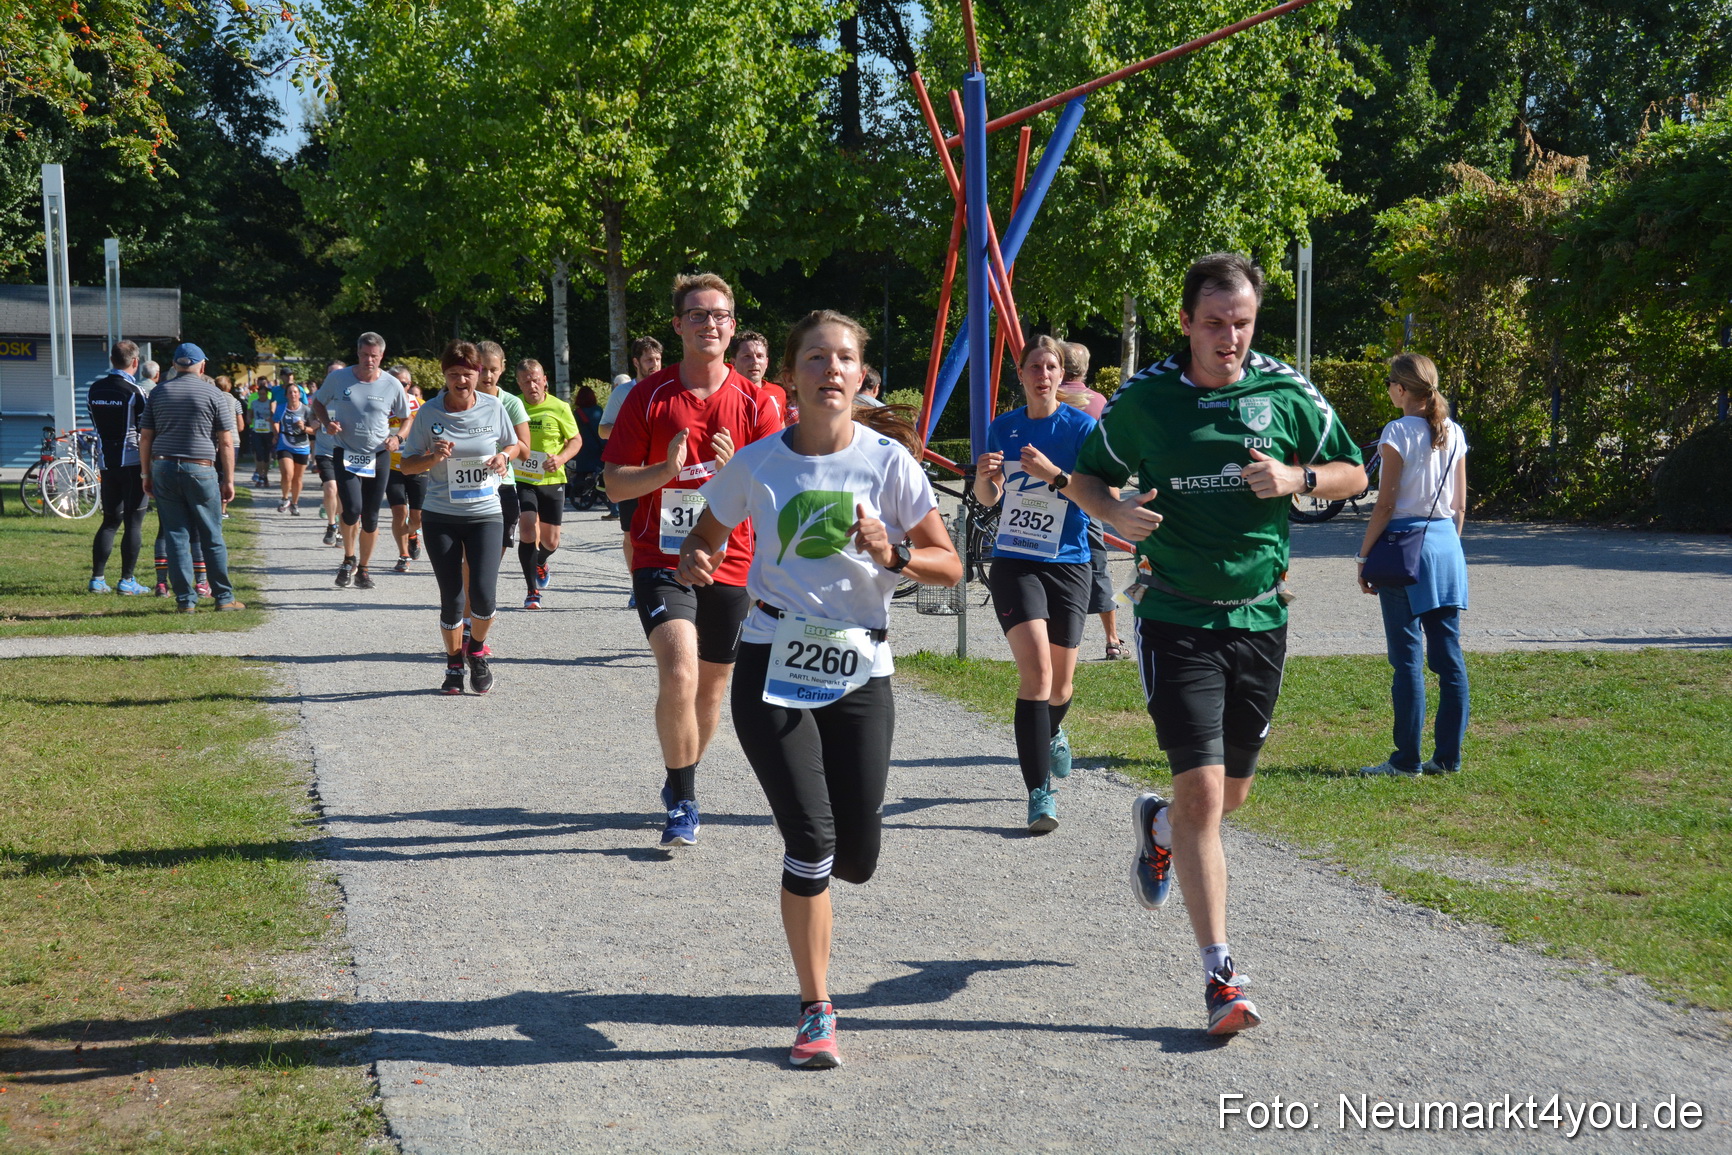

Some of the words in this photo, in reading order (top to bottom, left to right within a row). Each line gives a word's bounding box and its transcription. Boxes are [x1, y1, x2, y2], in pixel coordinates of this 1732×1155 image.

[1198, 400, 1229, 408] hummel
[469, 426, 493, 434] BOCK
[1244, 437, 1272, 448] PDU
[348, 454, 371, 465] 2595
[455, 467, 488, 484] 3105
[690, 466, 708, 476] DEHN
[682, 494, 707, 503] BOC
[1022, 498, 1048, 508] BOCK
[1009, 508, 1055, 534] 2352
[1012, 537, 1039, 550] Sabine
[804, 624, 848, 640] BOCK
[784, 640, 859, 677] 2260
[789, 672, 810, 682] PARTL
[811, 676, 841, 686] Neumarkt
[796, 687, 835, 700] Carina
